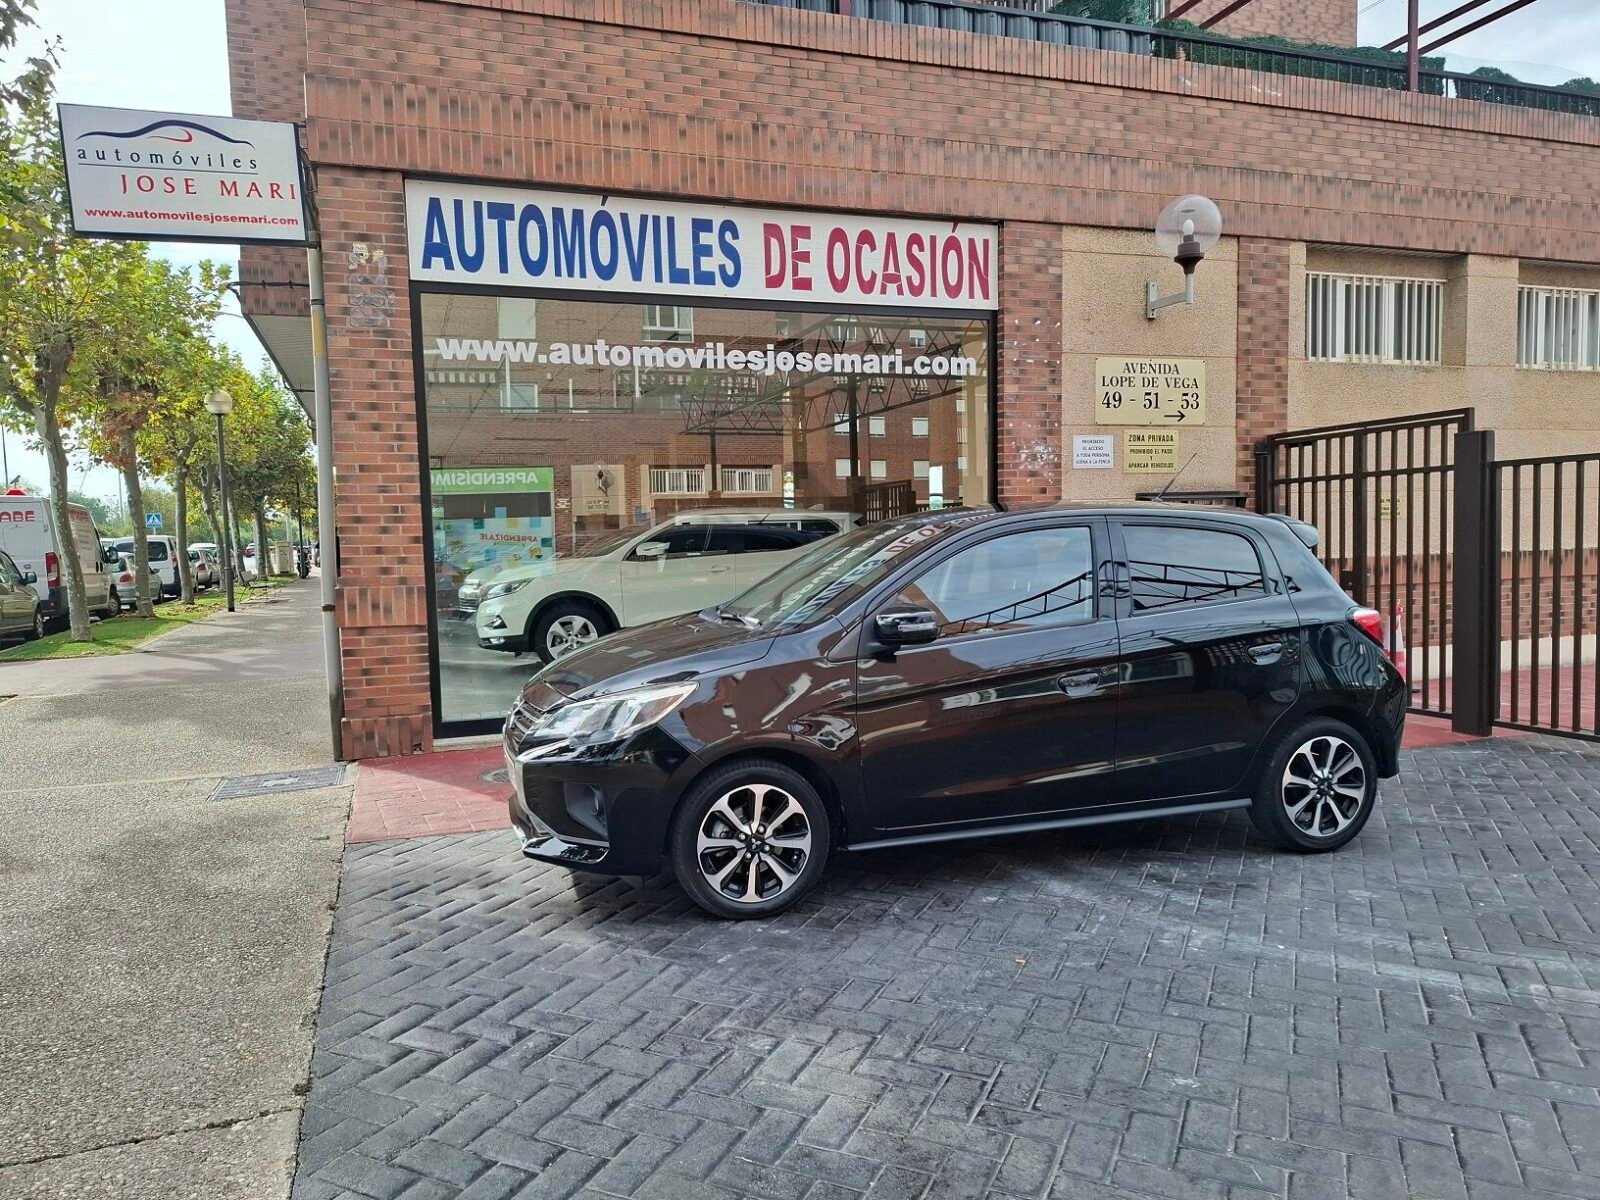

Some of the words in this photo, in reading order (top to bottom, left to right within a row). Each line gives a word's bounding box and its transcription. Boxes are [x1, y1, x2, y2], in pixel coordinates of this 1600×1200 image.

[77, 147, 258, 169] automóviles
[120, 174, 198, 195] JOSE
[219, 179, 297, 200] MARI
[84, 207, 299, 226] www.automovilesjosemari.com
[421, 194, 742, 288] AUTOMÓVILES
[762, 222, 813, 292] DE
[826, 221, 990, 300] OCASIÓN
[436, 338, 977, 376] www.automovilesjosemari.com
[1122, 362, 1180, 375] AVENIDA
[1101, 376, 1136, 388] LOPE
[1142, 376, 1159, 388] DE
[1165, 377, 1199, 389] VEGA
[1101, 391, 1122, 409] 49
[1143, 391, 1160, 410] 51
[1180, 392, 1200, 410] 53
[1128, 434, 1145, 442] ZONA
[1147, 434, 1174, 442] PRIVADA
